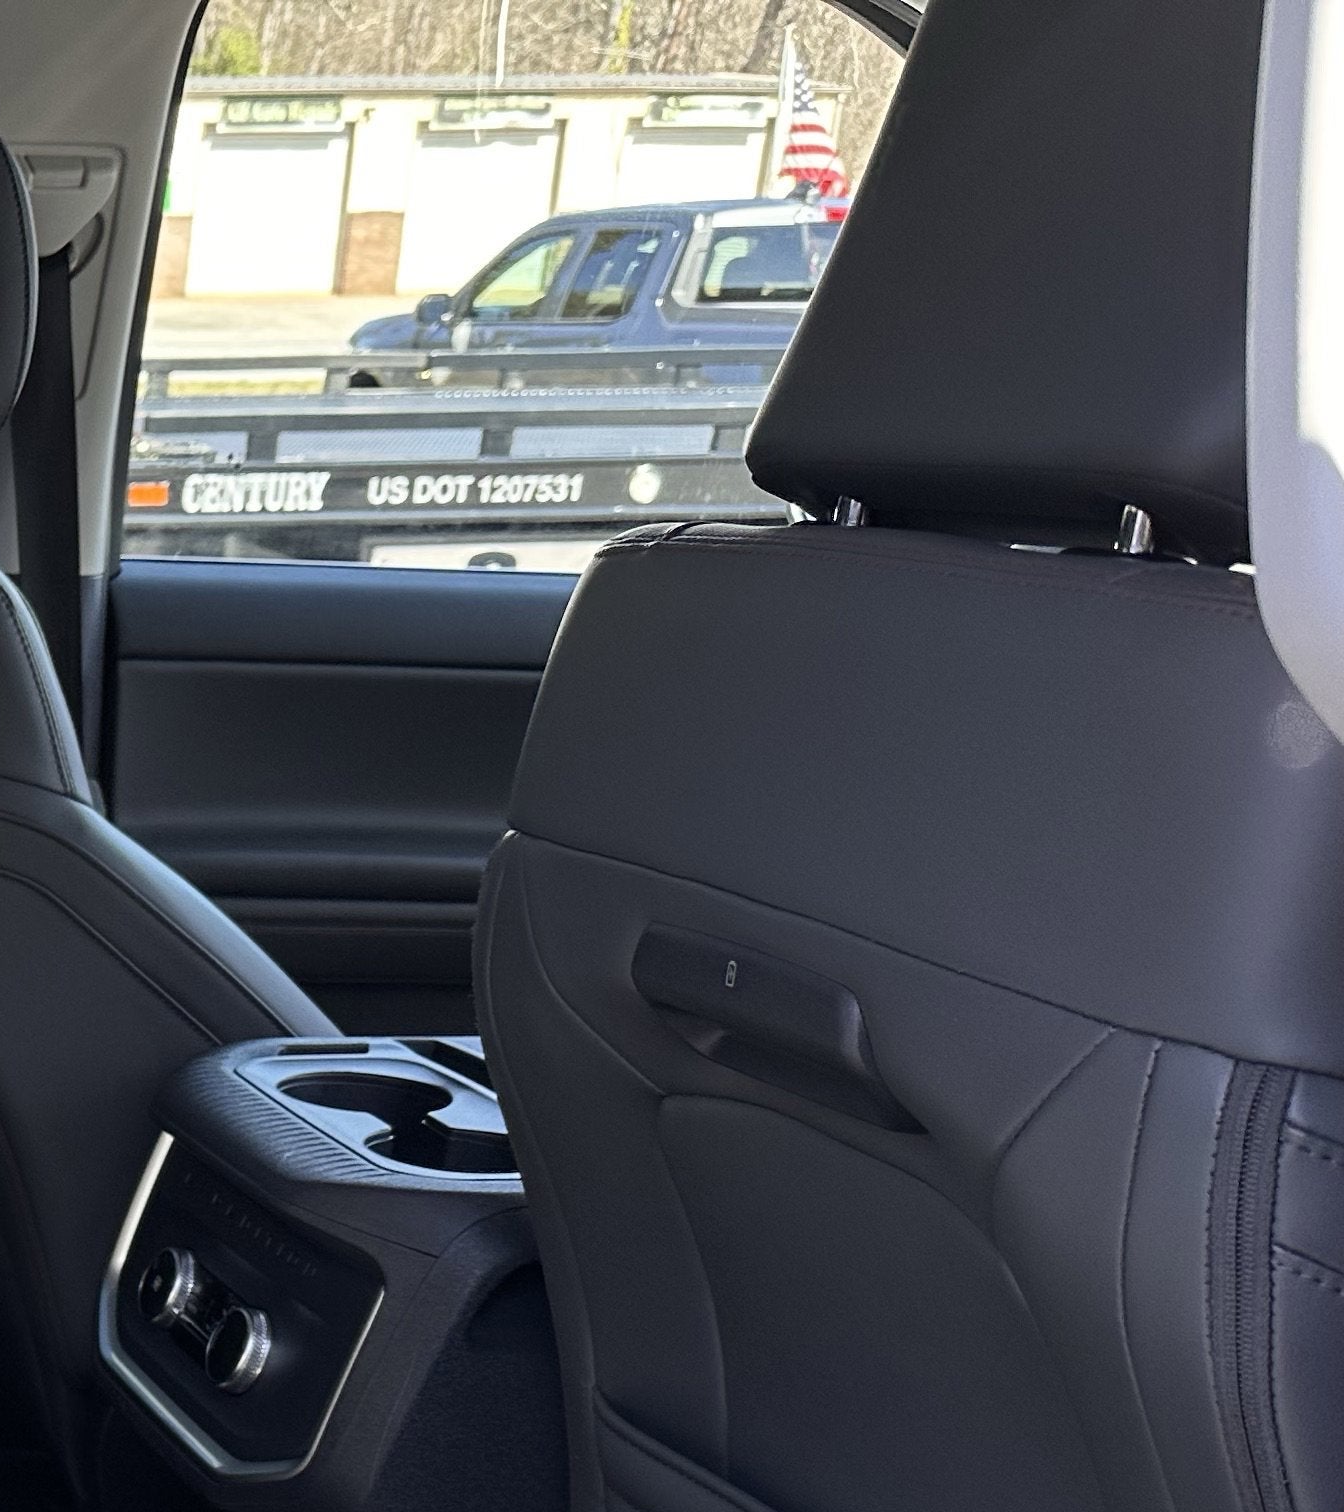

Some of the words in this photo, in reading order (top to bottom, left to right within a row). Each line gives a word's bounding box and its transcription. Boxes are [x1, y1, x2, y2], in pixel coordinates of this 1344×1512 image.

[181, 471, 331, 513] CENTURY
[367, 475, 410, 505] US
[412, 474, 475, 505] DOT
[477, 473, 584, 504] 1207531
